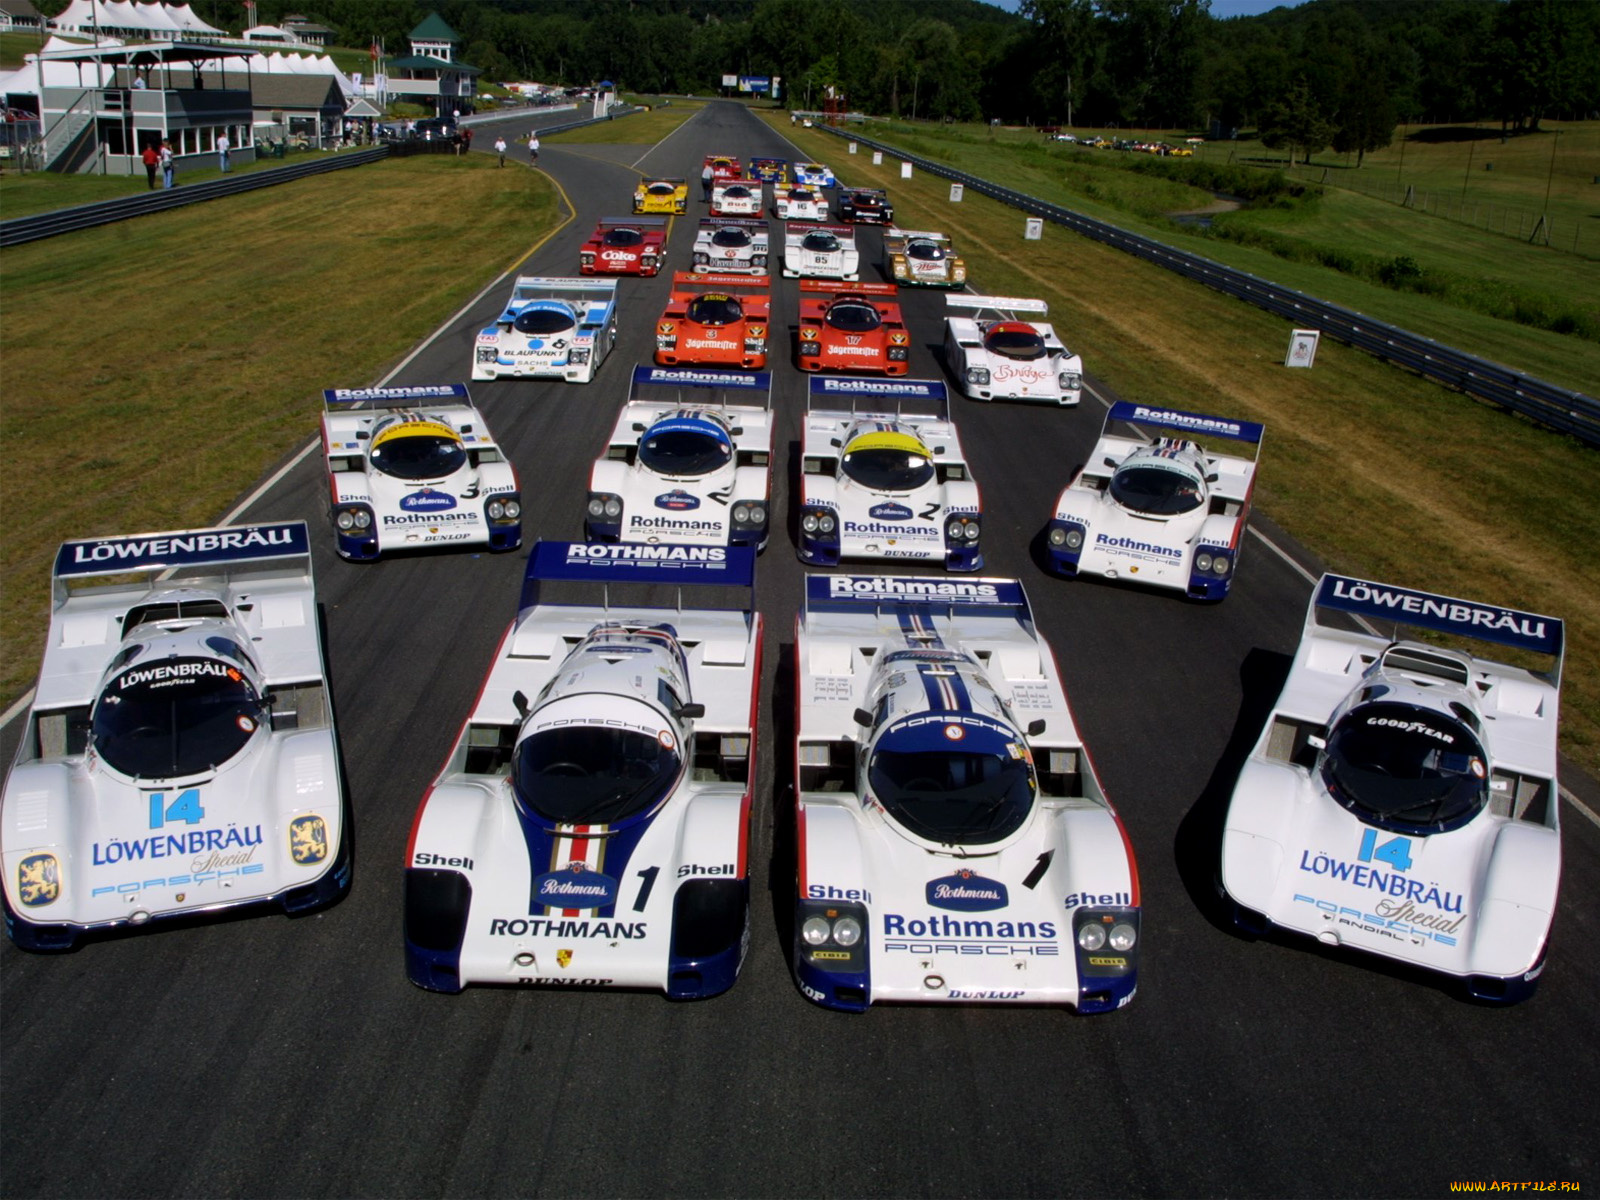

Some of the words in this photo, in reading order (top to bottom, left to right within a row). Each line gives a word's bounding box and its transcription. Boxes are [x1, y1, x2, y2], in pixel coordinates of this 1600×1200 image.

[601, 250, 637, 261] Coke
[685, 338, 738, 350] Jägermeister
[845, 336, 862, 346] 17
[827, 345, 879, 356] Jägermeister
[651, 370, 756, 382] Rothmans
[992, 364, 1054, 384] Bridge
[334, 384, 454, 398] Rothmans
[824, 379, 929, 393] Rothmans
[1135, 406, 1241, 432] Rothmans
[459, 478, 480, 500] 3
[481, 485, 514, 497] Shell
[405, 496, 451, 506] Rothmans
[383, 511, 478, 525] Rothmans
[918, 502, 941, 521] 2
[942, 506, 978, 516] Shell
[630, 515, 723, 530] Rothmans
[843, 521, 939, 536] Rothmans
[424, 533, 471, 542] DUNLOP
[629, 529, 722, 538] PORSCHE
[74, 528, 293, 564] LÖWENBRÄU
[567, 544, 727, 561] ROTHMANS
[883, 550, 931, 558] DUNLOP
[1095, 533, 1183, 558] Rothmans
[566, 559, 727, 570] PORSCHE
[1093, 547, 1181, 566] PORSCHE
[830, 576, 998, 596] Rothmans
[830, 593, 999, 602] PORSCHE
[1333, 580, 1546, 639] LÖWENBRÄU
[120, 661, 228, 690] LÖWENBRÄU
[150, 678, 196, 688] GOODYEAR
[536, 718, 658, 736] PORSCHE
[890, 716, 1014, 739] PORSCHE
[1367, 717, 1454, 744] GOODYEAR
[149, 788, 205, 829] 14
[92, 823, 263, 866] LÖWENBRÄU
[1357, 828, 1413, 873] 14
[190, 846, 258, 875] Special
[414, 853, 475, 871] Shell
[677, 864, 735, 879] Shell
[92, 864, 265, 898] PORSCHE
[540, 878, 609, 896] Rothmans
[632, 866, 660, 912] 1
[1300, 850, 1463, 914] LÖWENBRÄU
[808, 884, 872, 905] Shell
[935, 884, 1001, 900] Rothmans
[1064, 892, 1130, 910] Shell
[1294, 894, 1457, 946] PORSCHE
[1375, 898, 1468, 934] Special
[489, 918, 647, 940] ROTHMANS
[884, 914, 1057, 938] Rothmans
[1338, 917, 1405, 942] ANDIAL
[815, 952, 849, 960] CIBIE
[885, 943, 1059, 956] PORSCHE
[1092, 957, 1126, 965] CIBIE
[518, 977, 614, 986] DUNLOP
[948, 990, 1026, 999] DUNLOP
